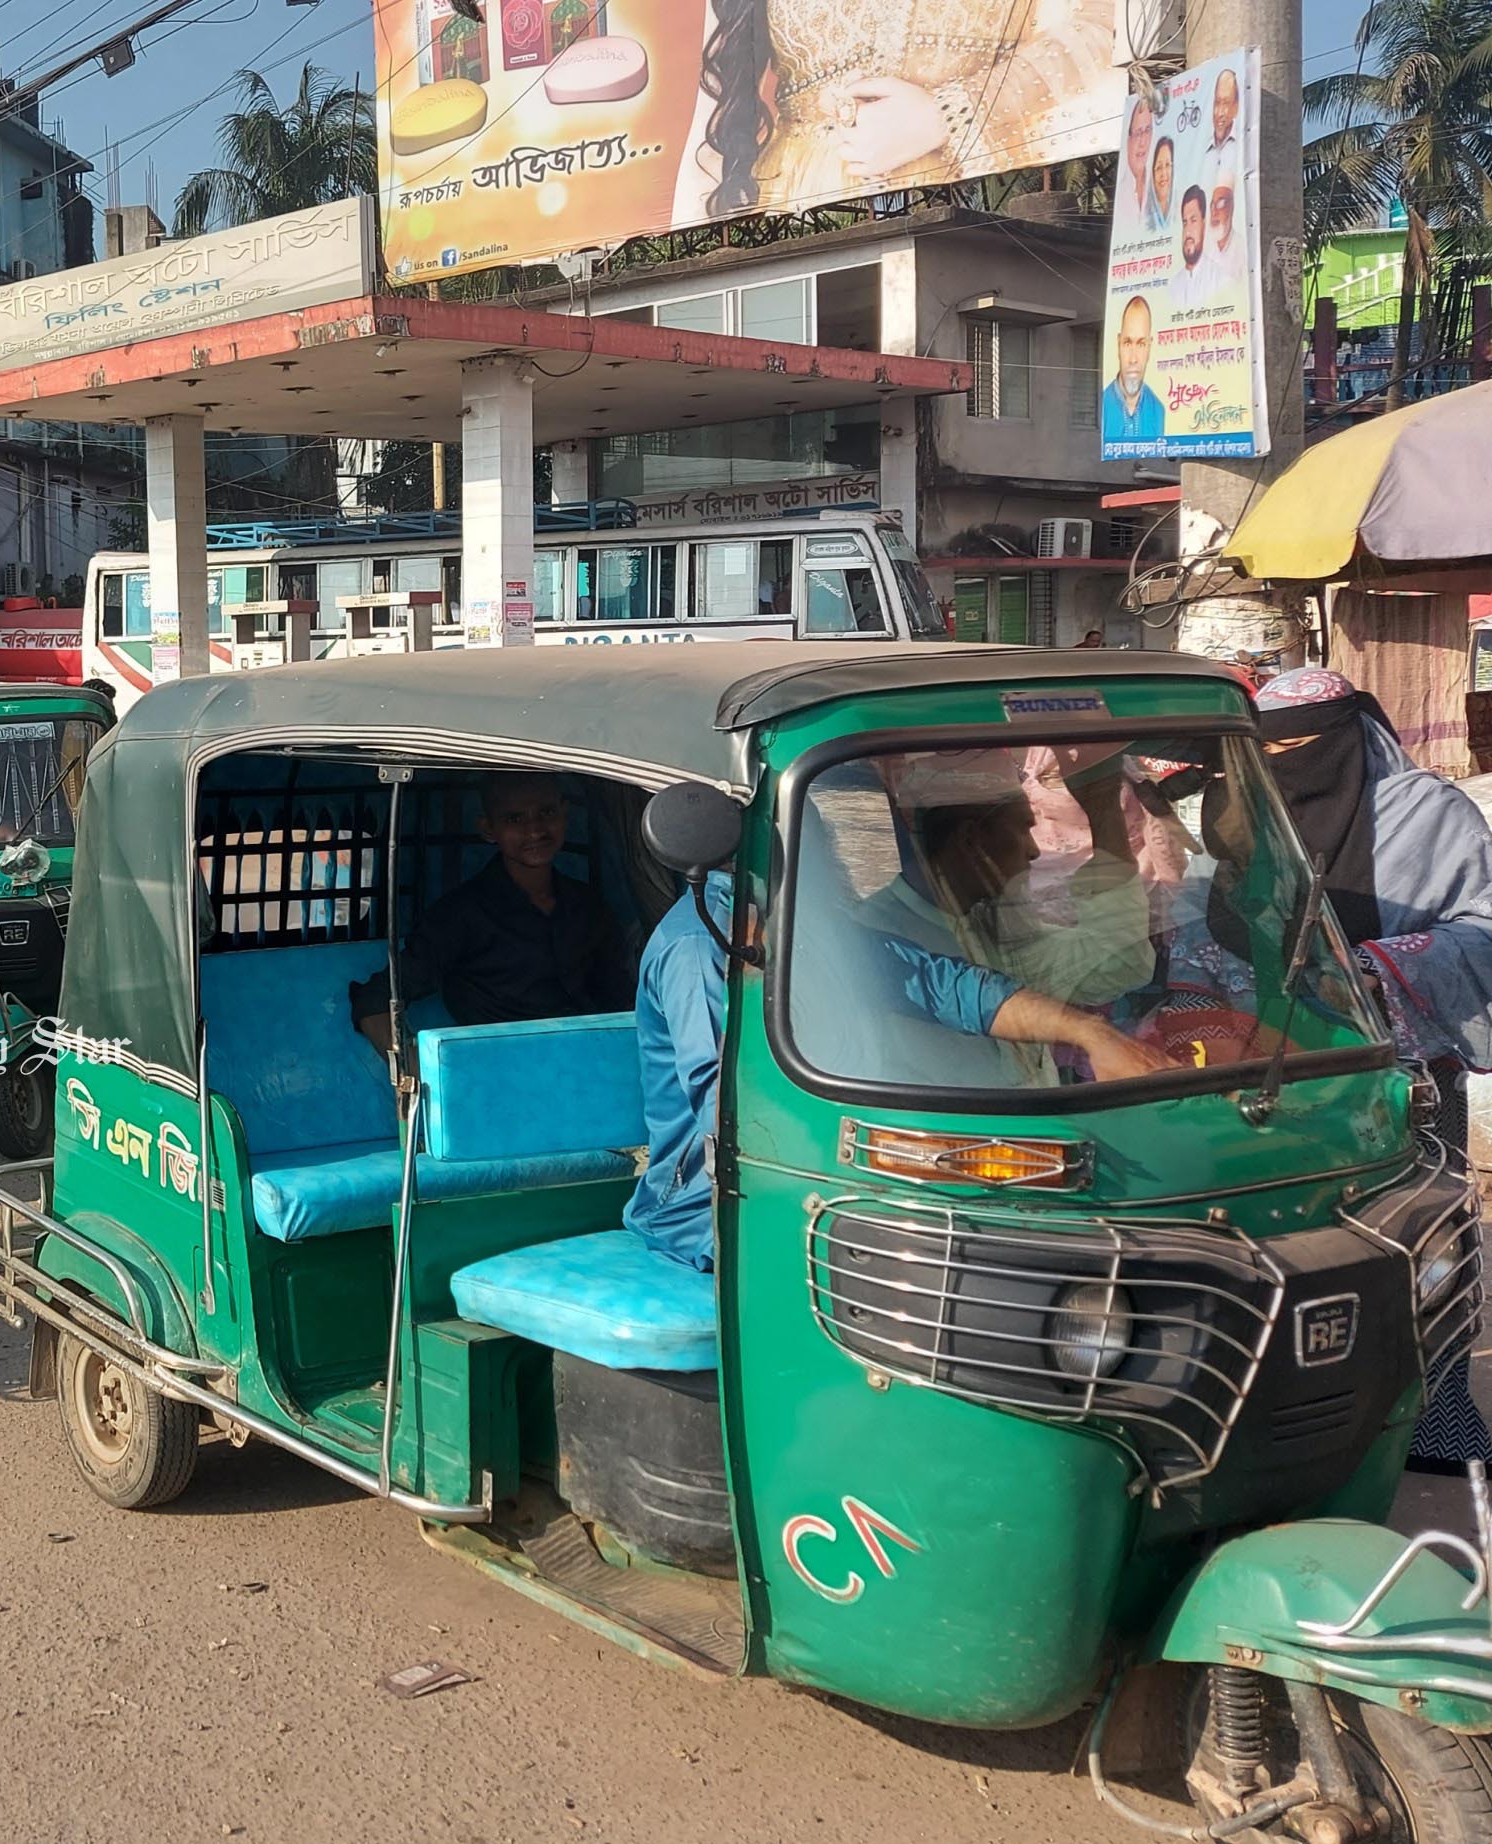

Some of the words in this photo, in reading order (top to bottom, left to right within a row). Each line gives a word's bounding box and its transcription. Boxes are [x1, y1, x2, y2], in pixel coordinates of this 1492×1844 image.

[399, 175, 464, 209] রূপচর্চায়
[123, 244, 216, 290] অটো
[224, 210, 357, 265] সার্ভিস
[414, 262, 425, 270] us
[426, 260, 438, 268] on
[44, 301, 128, 329] ফিলিং
[693, 493, 758, 518] বরিশাল
[763, 483, 810, 508] অটো
[816, 475, 877, 504] সার্ভিস
[1, 629, 55, 648] বরিশাল
[1010, 698, 1100, 713] RUNNER
[66, 1077, 101, 1150] সি
[106, 1118, 153, 1178] এন
[158, 1121, 199, 1202] জি
[1308, 1317, 1348, 1353] RE
